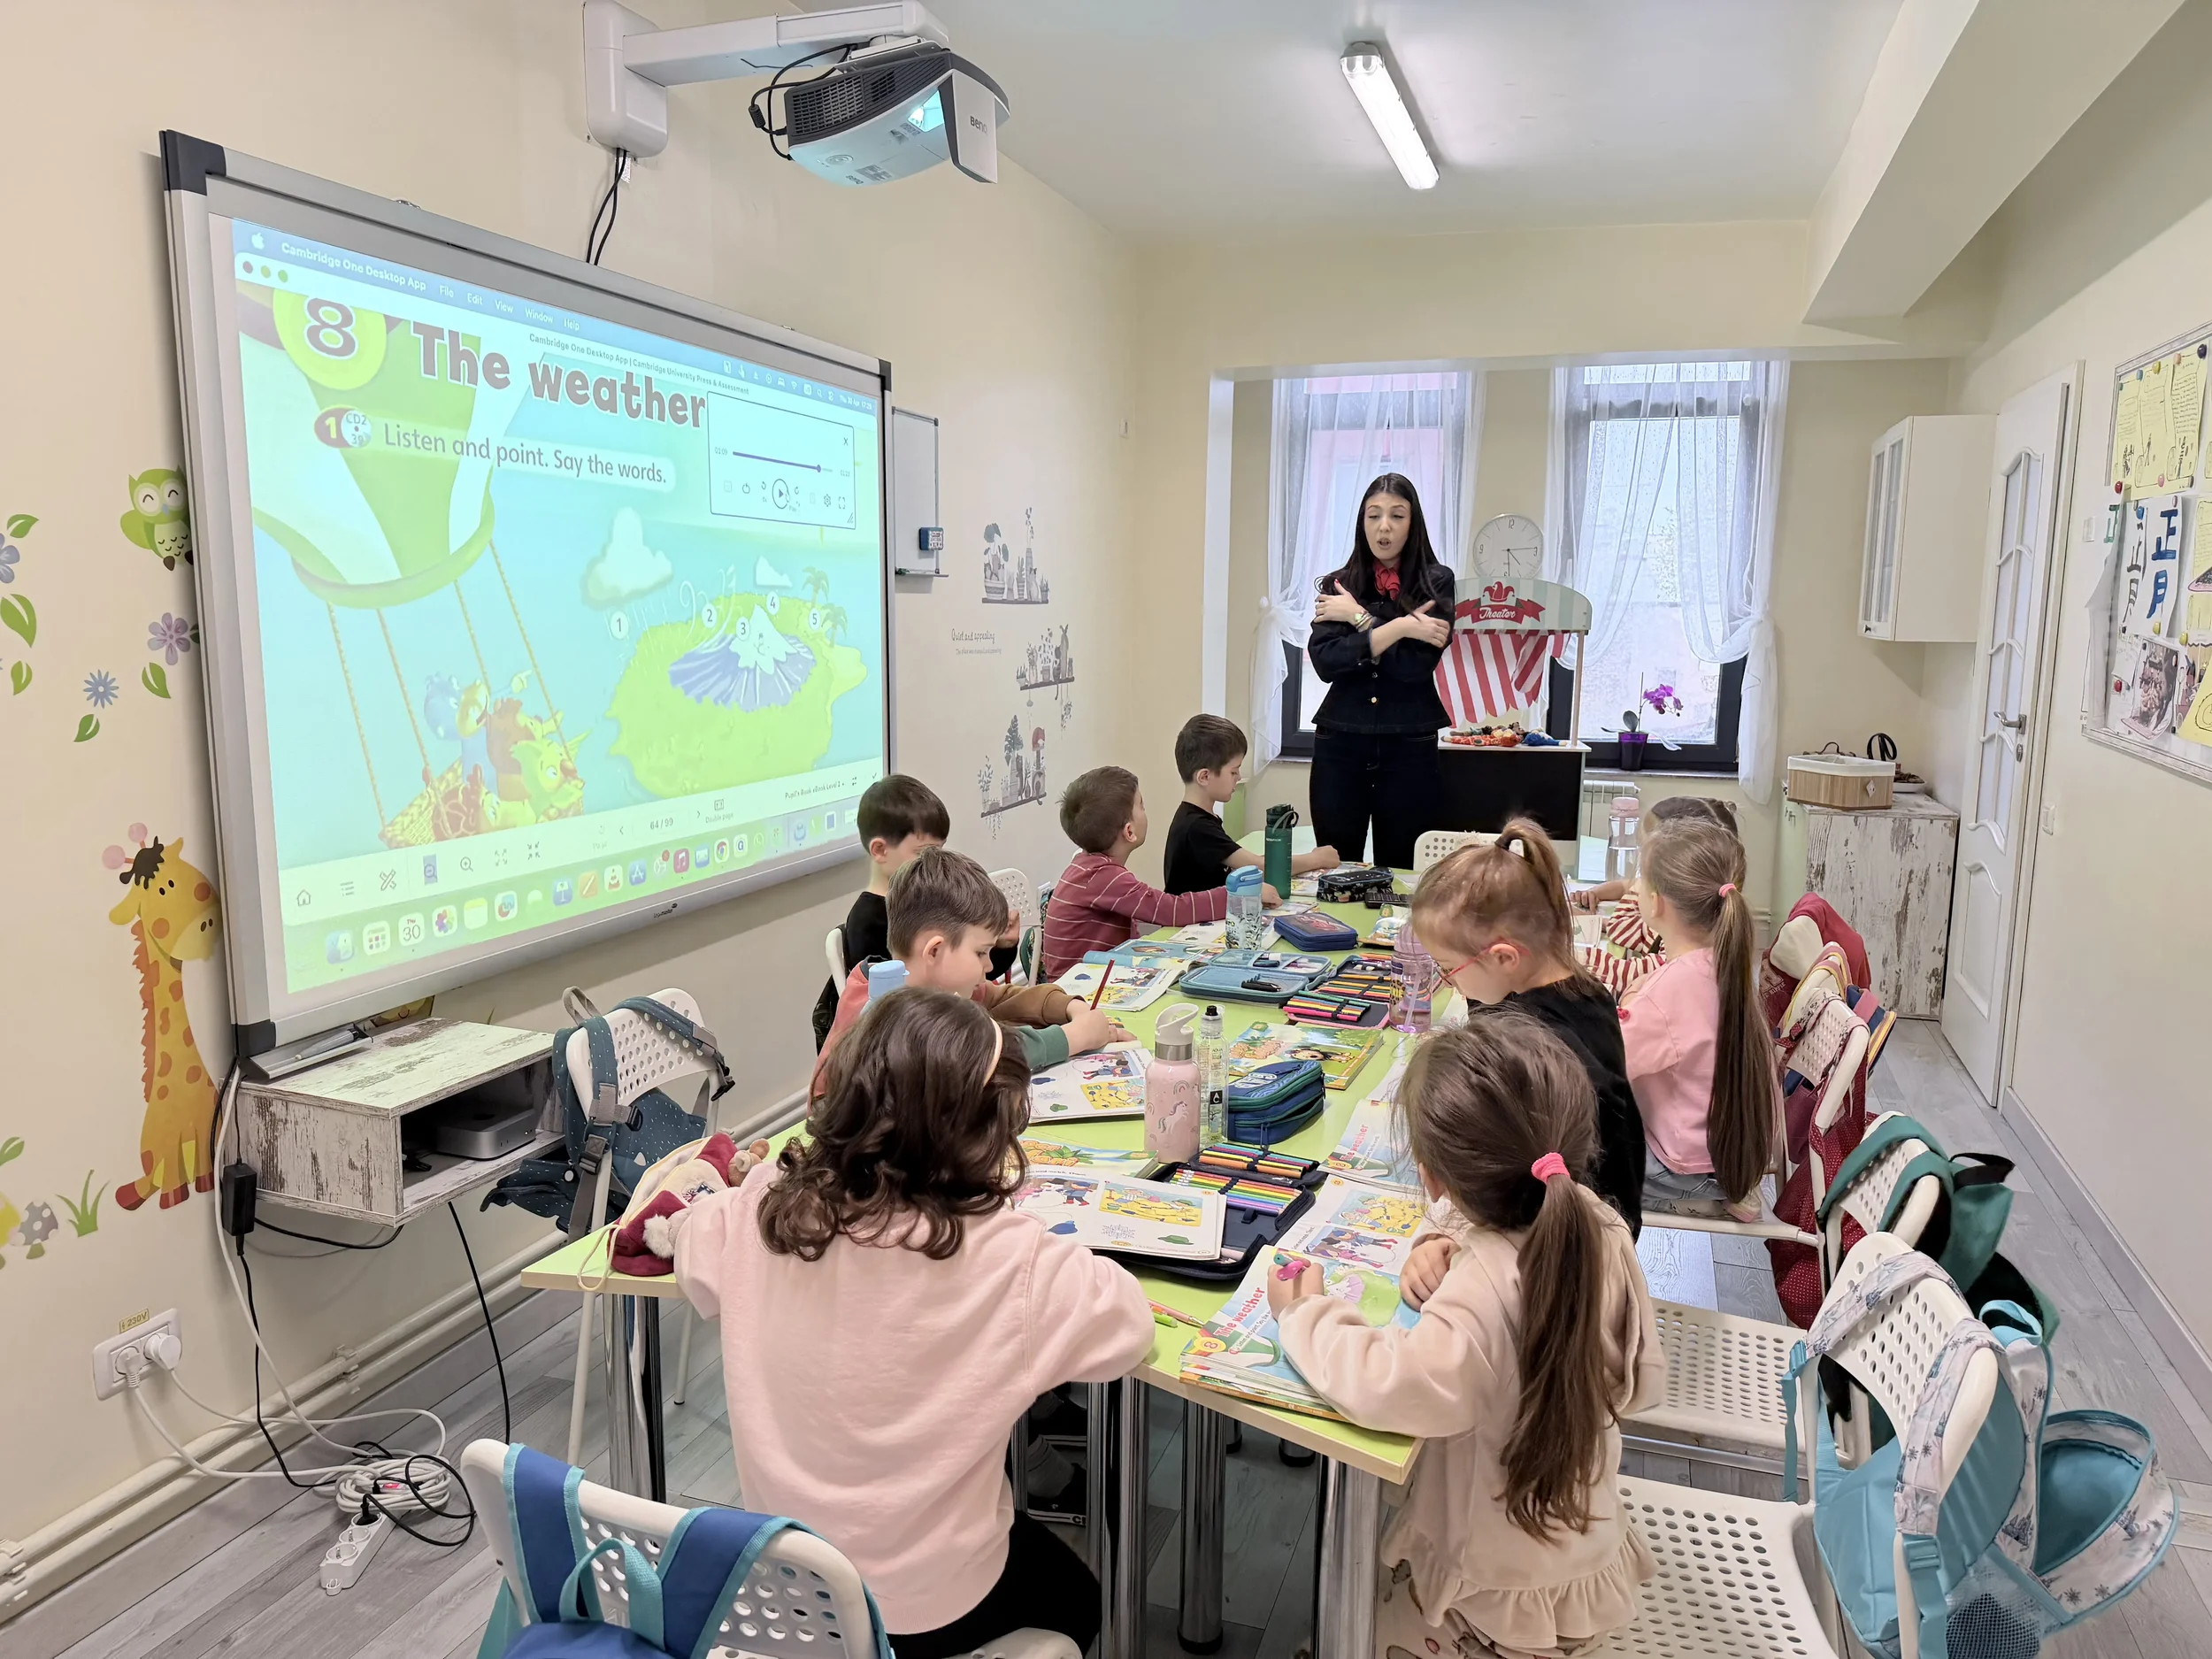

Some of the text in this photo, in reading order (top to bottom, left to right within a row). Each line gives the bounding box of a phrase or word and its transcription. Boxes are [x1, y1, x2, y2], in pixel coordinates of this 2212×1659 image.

[281, 242, 580, 332] Cambridge One Desktop App File Edit View Window Help
[304, 296, 357, 358] 8
[529, 333, 570, 351] Cambridge
[571, 343, 585, 354] One
[586, 347, 614, 361] Desktop
[615, 354, 628, 366] App
[633, 357, 666, 374] Cambridge
[666, 367, 696, 383] University
[696, 374, 712, 386] Press
[718, 380, 749, 396] Assessment
[412, 320, 706, 428] The weather
[345, 412, 367, 426] CD2
[325, 416, 337, 439] 1
[384, 422, 667, 484] Listen and point. Say the words.
[1508, 518, 1515, 529] 12
[1479, 543, 1484, 554] 9
[1532, 546, 1538, 557] 3
[770, 595, 776, 610] 4
[706, 608, 713, 623] 2
[811, 612, 818, 626] 5
[1479, 606, 1516, 619] Theater
[616, 618, 622, 633] 1
[740, 621, 747, 636] 3
[403, 924, 421, 941] 30
[127, 1311, 148, 1327] 230V
[1214, 1286, 1265, 1337] The weather
[1203, 1340, 1218, 1349] 8
